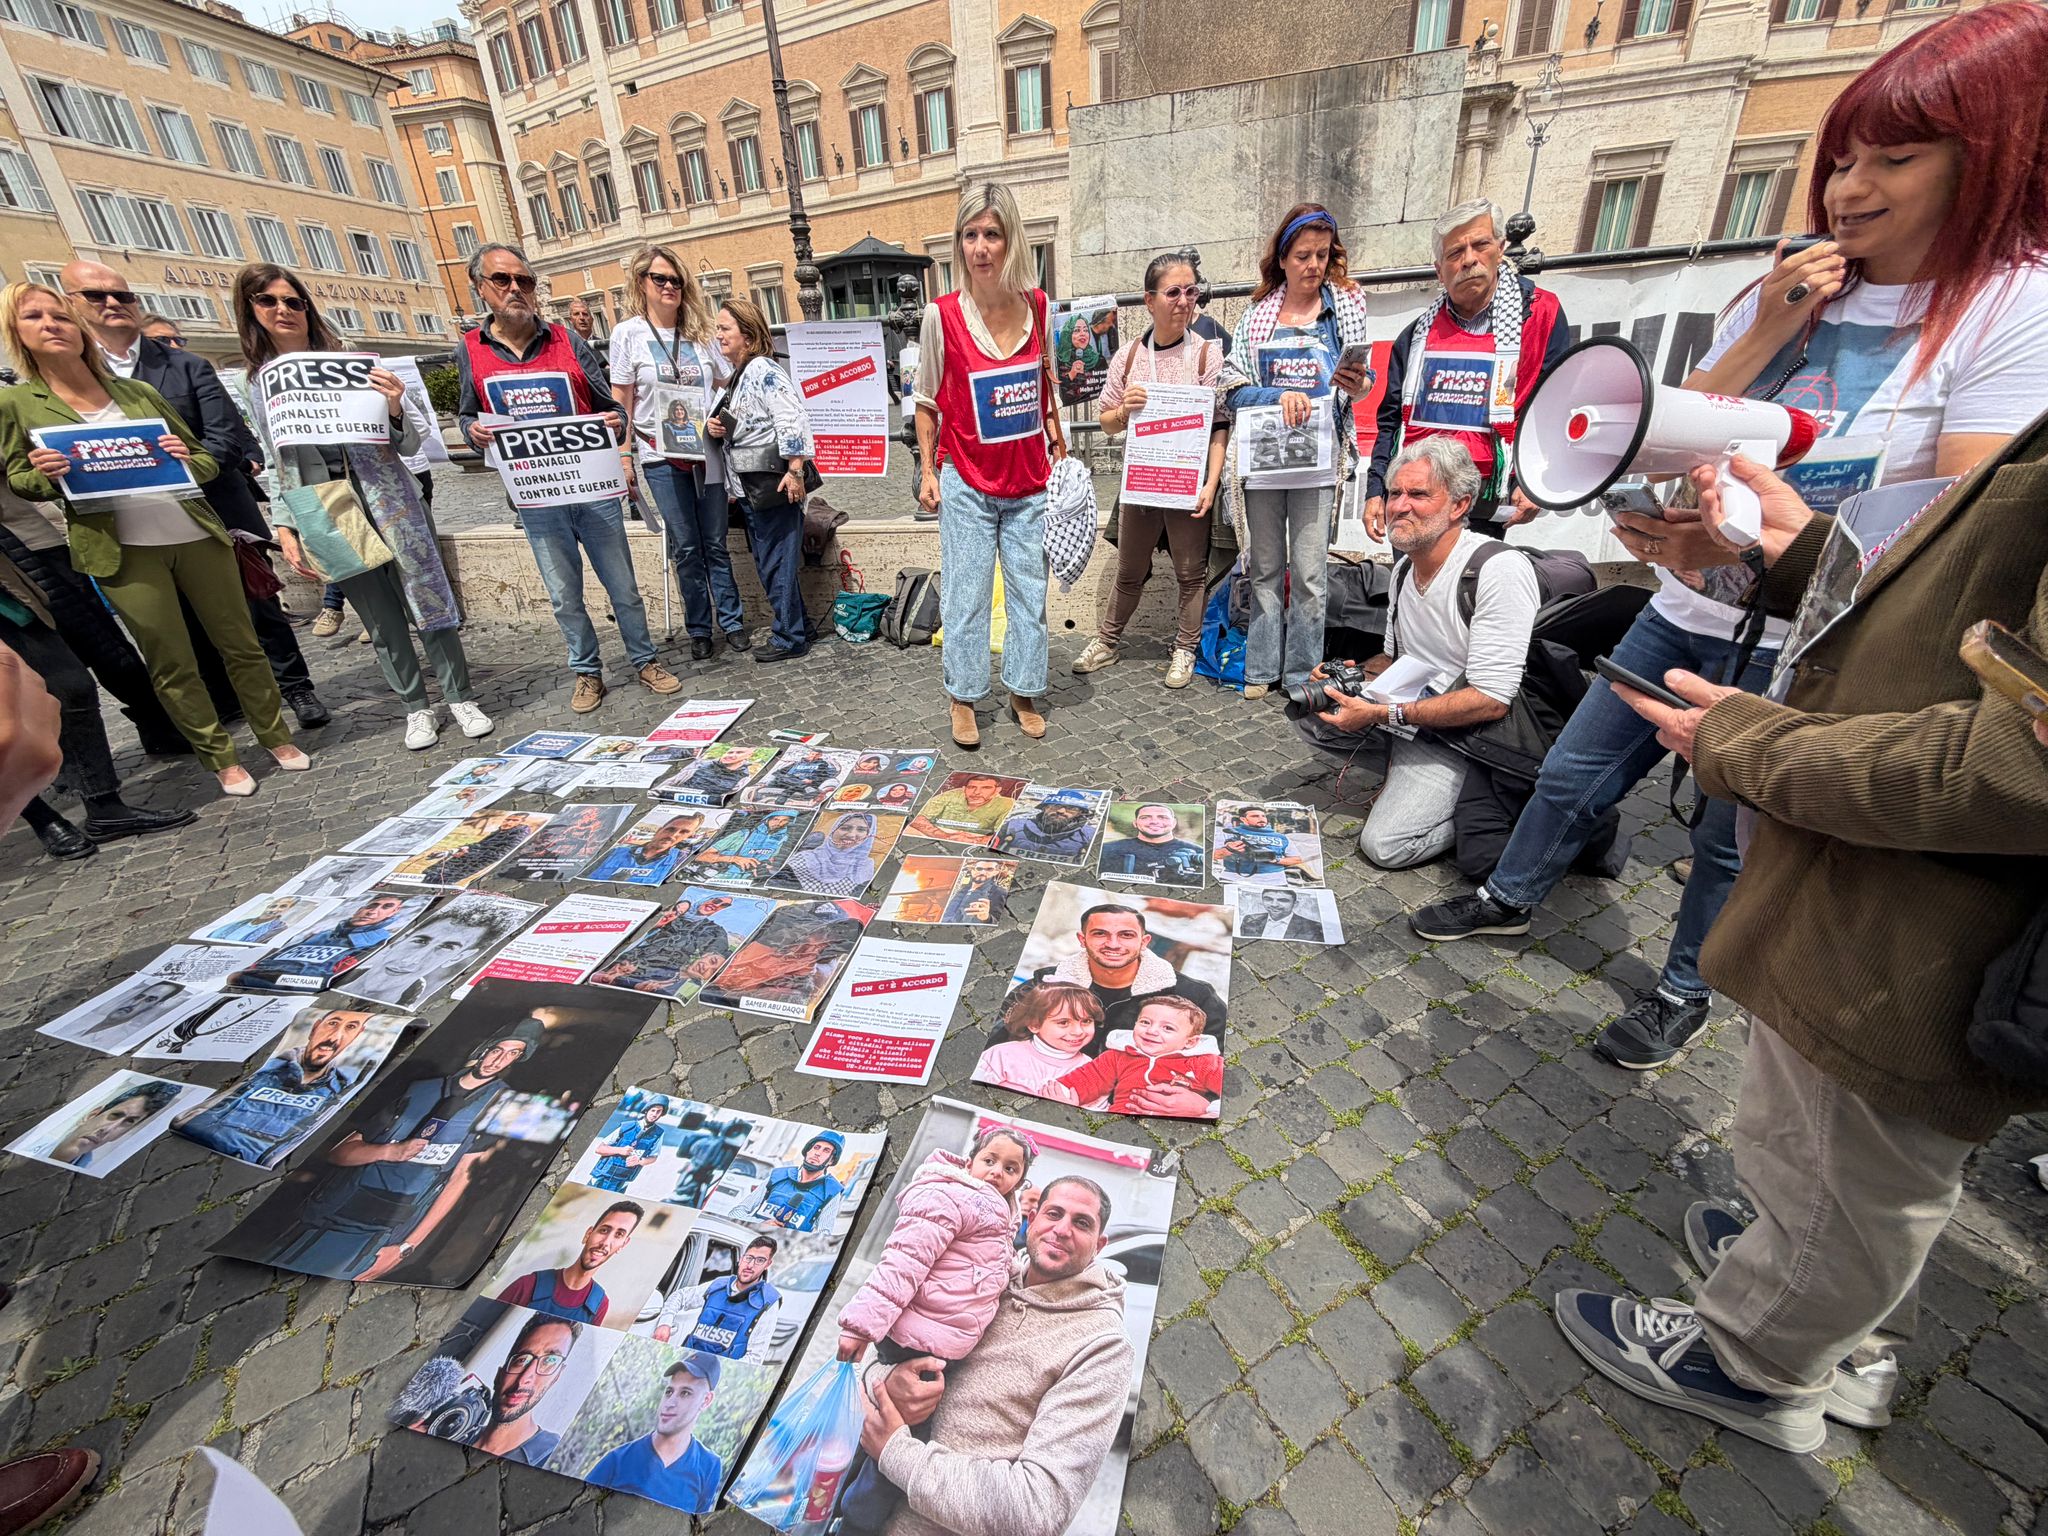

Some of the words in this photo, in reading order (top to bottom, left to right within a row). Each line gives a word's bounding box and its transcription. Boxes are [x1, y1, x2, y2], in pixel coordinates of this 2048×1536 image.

[165, 265, 236, 288] ALBE
[1273, 358, 1318, 376] PRESS
[264, 361, 371, 398] PRESS
[804, 382, 820, 393] NON
[822, 374, 837, 386] C'È
[839, 362, 872, 380] ACCORDO
[1432, 370, 1488, 392] PRESS
[504, 387, 553, 406] PRESS
[994, 380, 1038, 405] PRESS
[270, 408, 341, 427] GIORNALISTI
[1137, 425, 1151, 433] NON
[1171, 418, 1201, 428] ACCORDO
[272, 424, 312, 440] CONTRO
[316, 424, 333, 434] LE
[336, 423, 385, 434] GUERRE
[500, 423, 605, 458] PRESS
[74, 437, 149, 460] PRESS
[508, 454, 581, 471] #NOBAVAGLIO
[513, 470, 582, 486] GIORNALISTI
[519, 487, 561, 500] CONTRO
[564, 485, 577, 495] LE
[579, 479, 620, 493] GUERRE
[879, 981, 896, 990] C'È
[902, 977, 943, 988] ACCORDO
[745, 1000, 767, 1009] SAMER
[782, 1004, 806, 1014] DAQQA
[834, 1050, 865, 1059] chiedono
[848, 1041, 882, 1049] cittadini
[872, 1048, 907, 1056] italiani)
[255, 1089, 320, 1108] PRESS
[695, 1324, 734, 1345] PRESS
